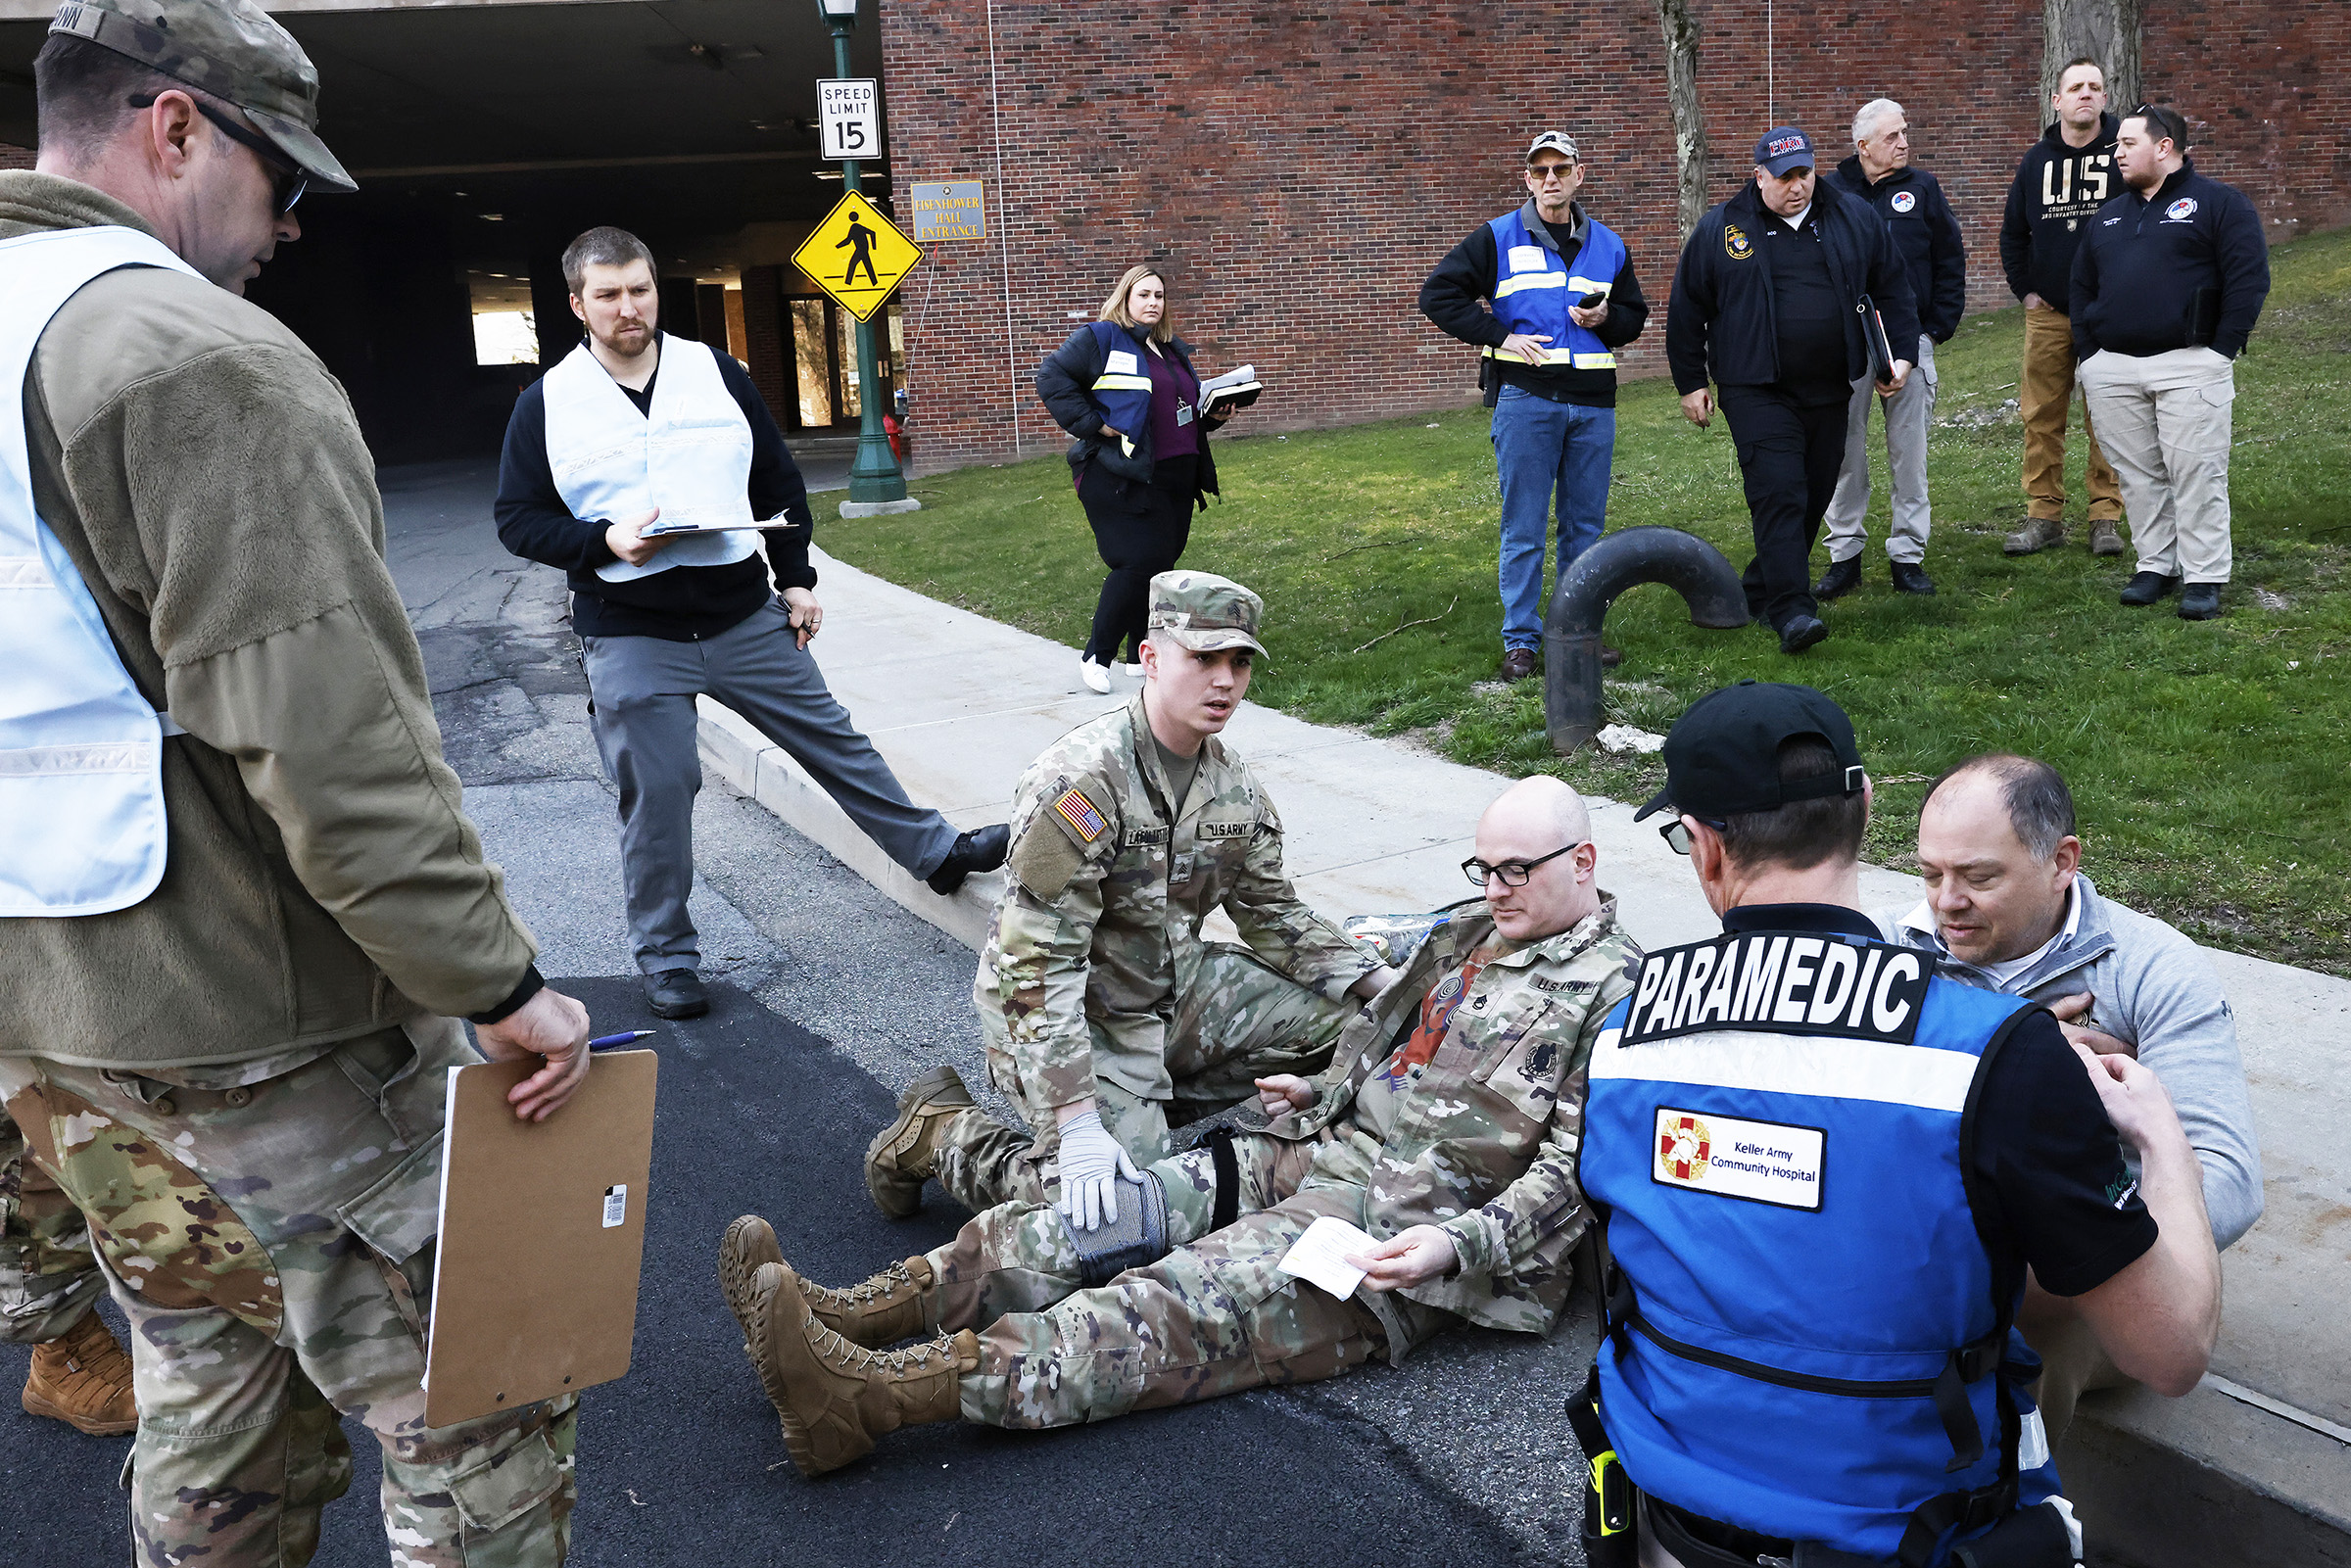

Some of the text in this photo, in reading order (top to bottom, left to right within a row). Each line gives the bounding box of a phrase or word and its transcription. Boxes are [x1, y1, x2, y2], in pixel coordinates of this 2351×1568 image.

[824, 88, 872, 100] SPEED
[830, 102, 867, 115] LIMIT
[836, 121, 865, 150] 15
[1770, 139, 1805, 154] FIRE
[2042, 154, 2110, 206] US
[915, 197, 980, 213] EISENHOWER
[936, 213, 962, 224] HALL
[921, 224, 979, 239] ENTRANCE
[1624, 935, 1920, 1038] PARAMEDIC
[1734, 1142, 1794, 1163] Keller Army
[1711, 1156, 1815, 1182] Community Hospital
